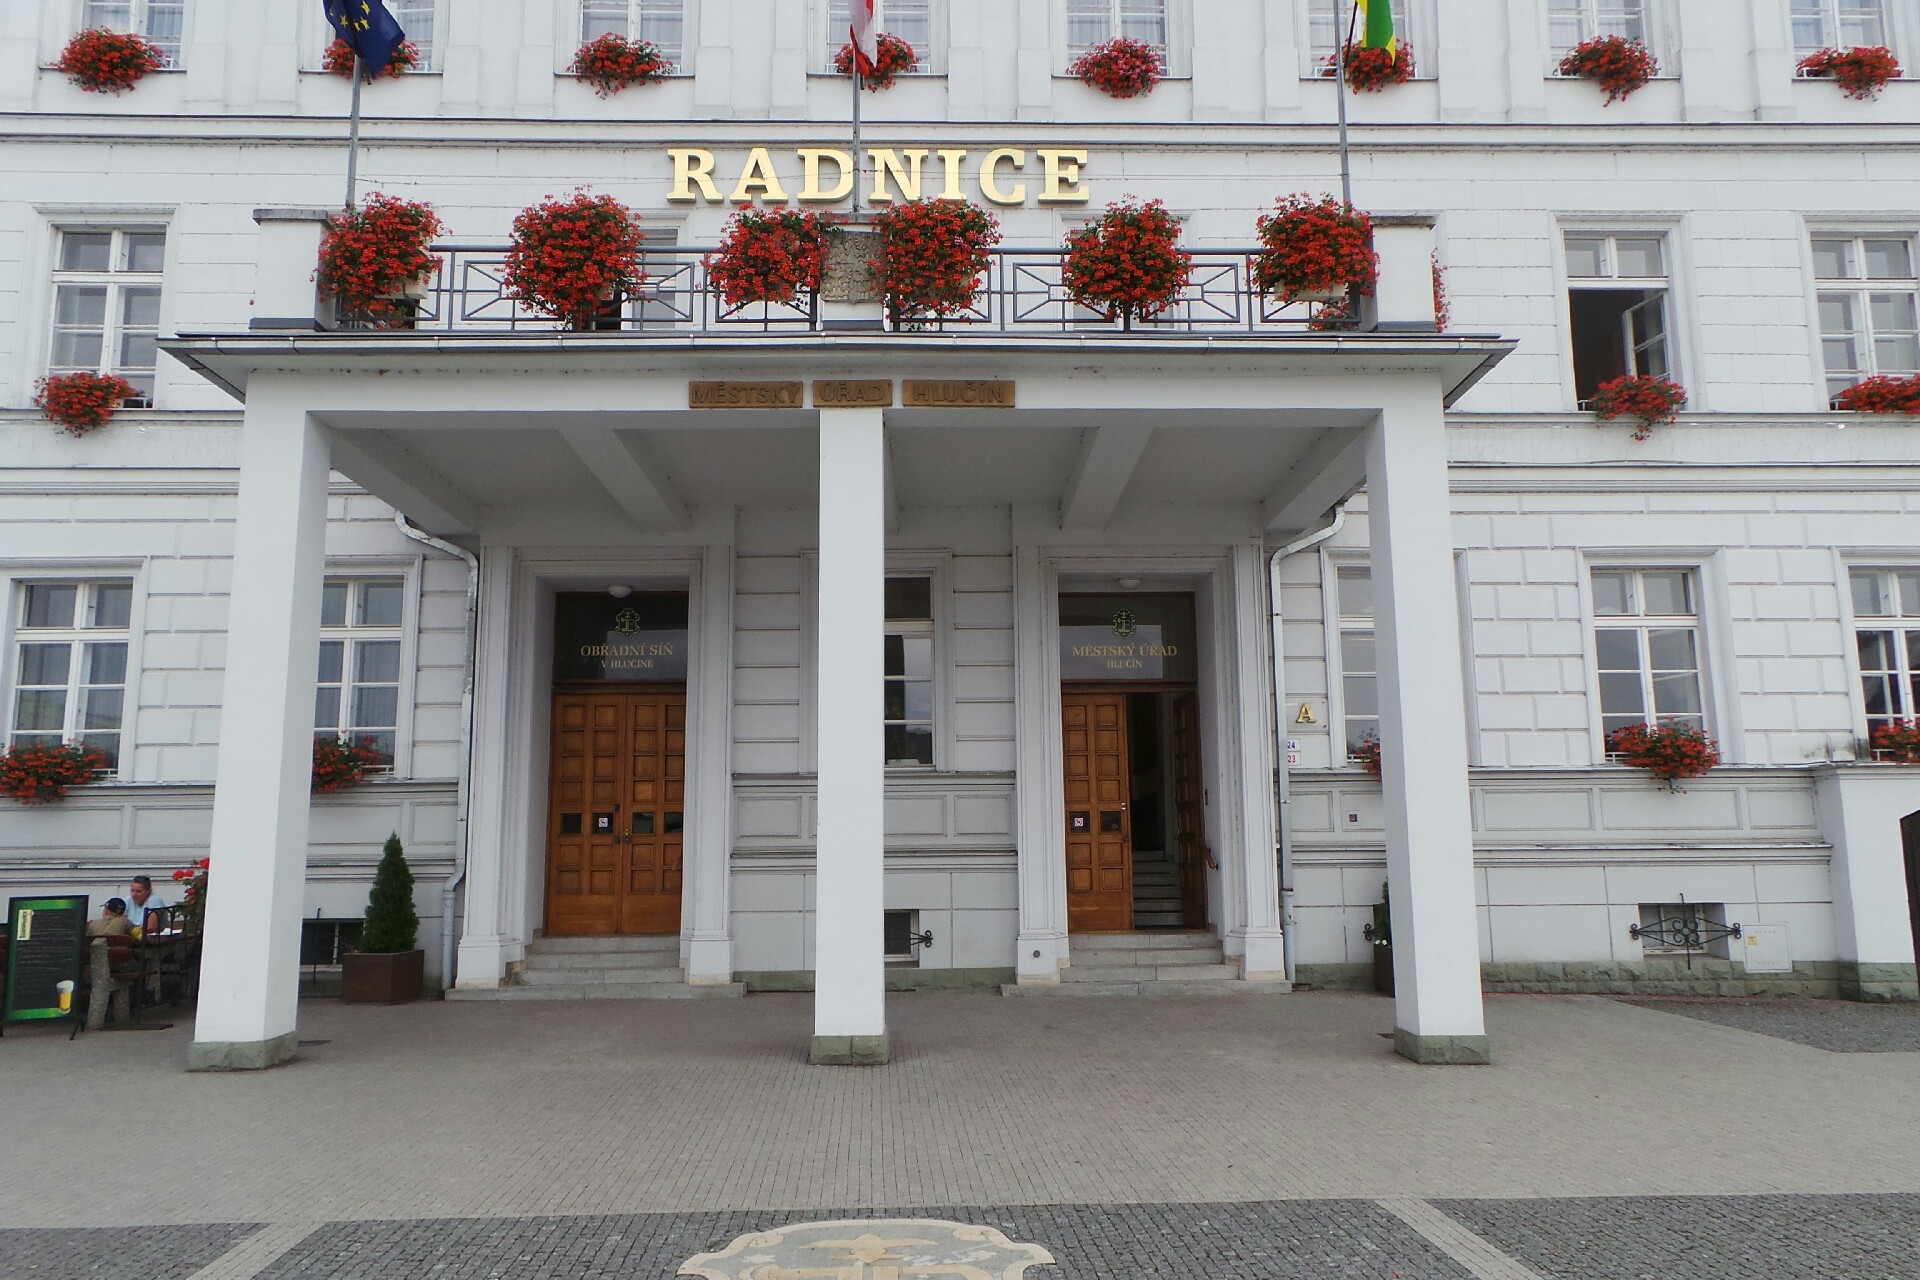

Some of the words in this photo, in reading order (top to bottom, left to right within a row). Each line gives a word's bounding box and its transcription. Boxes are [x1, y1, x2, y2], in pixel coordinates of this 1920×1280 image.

[666, 147, 1090, 205] RADNICE
[692, 381, 801, 404] MĚSTSKÝ
[819, 380, 884, 402] ÚŘAD
[913, 381, 1005, 403] HLUČÍN
[580, 643, 644, 656] OBŘADNÍ
[1072, 643, 1135, 656] MĚSTSKÝ
[1139, 643, 1178, 656] ÚŘAD
[601, 660, 608, 668] V
[1295, 703, 1317, 724] A
